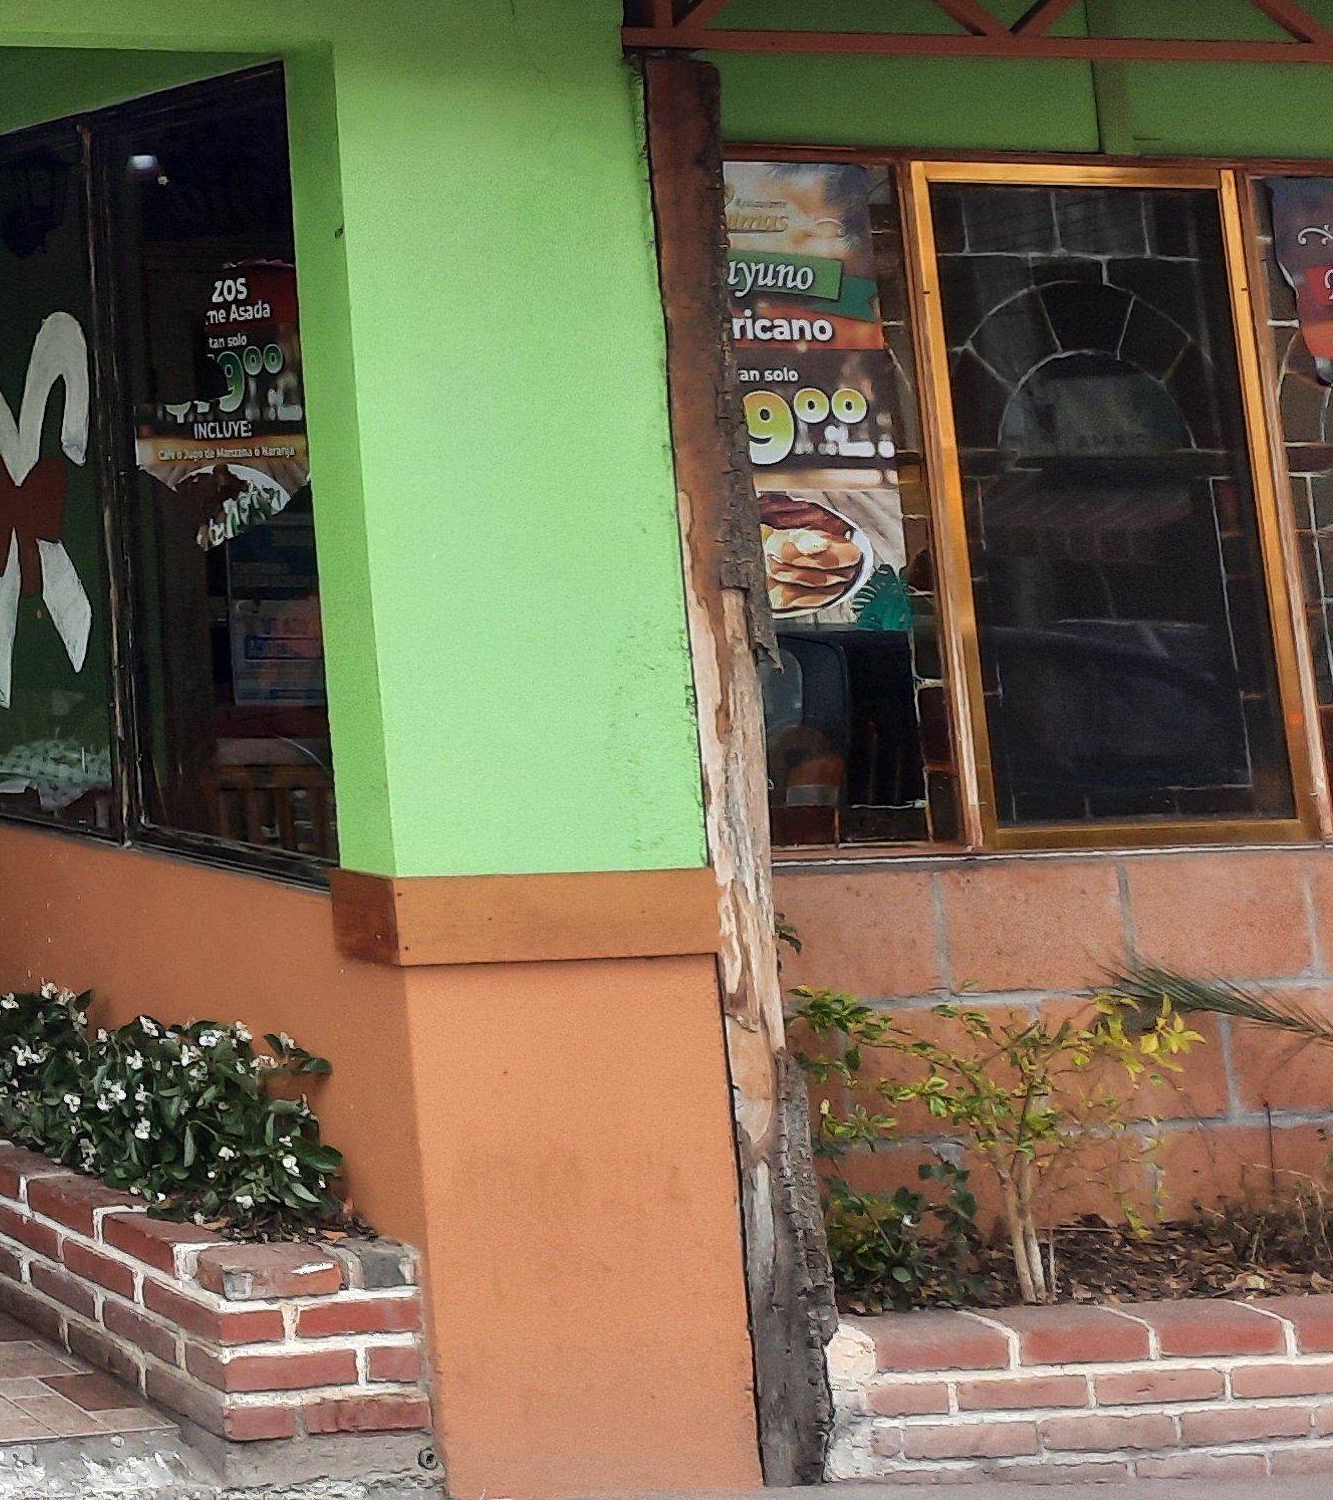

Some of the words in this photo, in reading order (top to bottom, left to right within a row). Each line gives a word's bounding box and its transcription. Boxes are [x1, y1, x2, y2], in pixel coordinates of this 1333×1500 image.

[230, 299, 271, 323] Asada
[209, 337, 225, 348] tan
[227, 333, 248, 347] solo
[764, 368, 799, 382] solo
[193, 421, 252, 439] INCLUYE:
